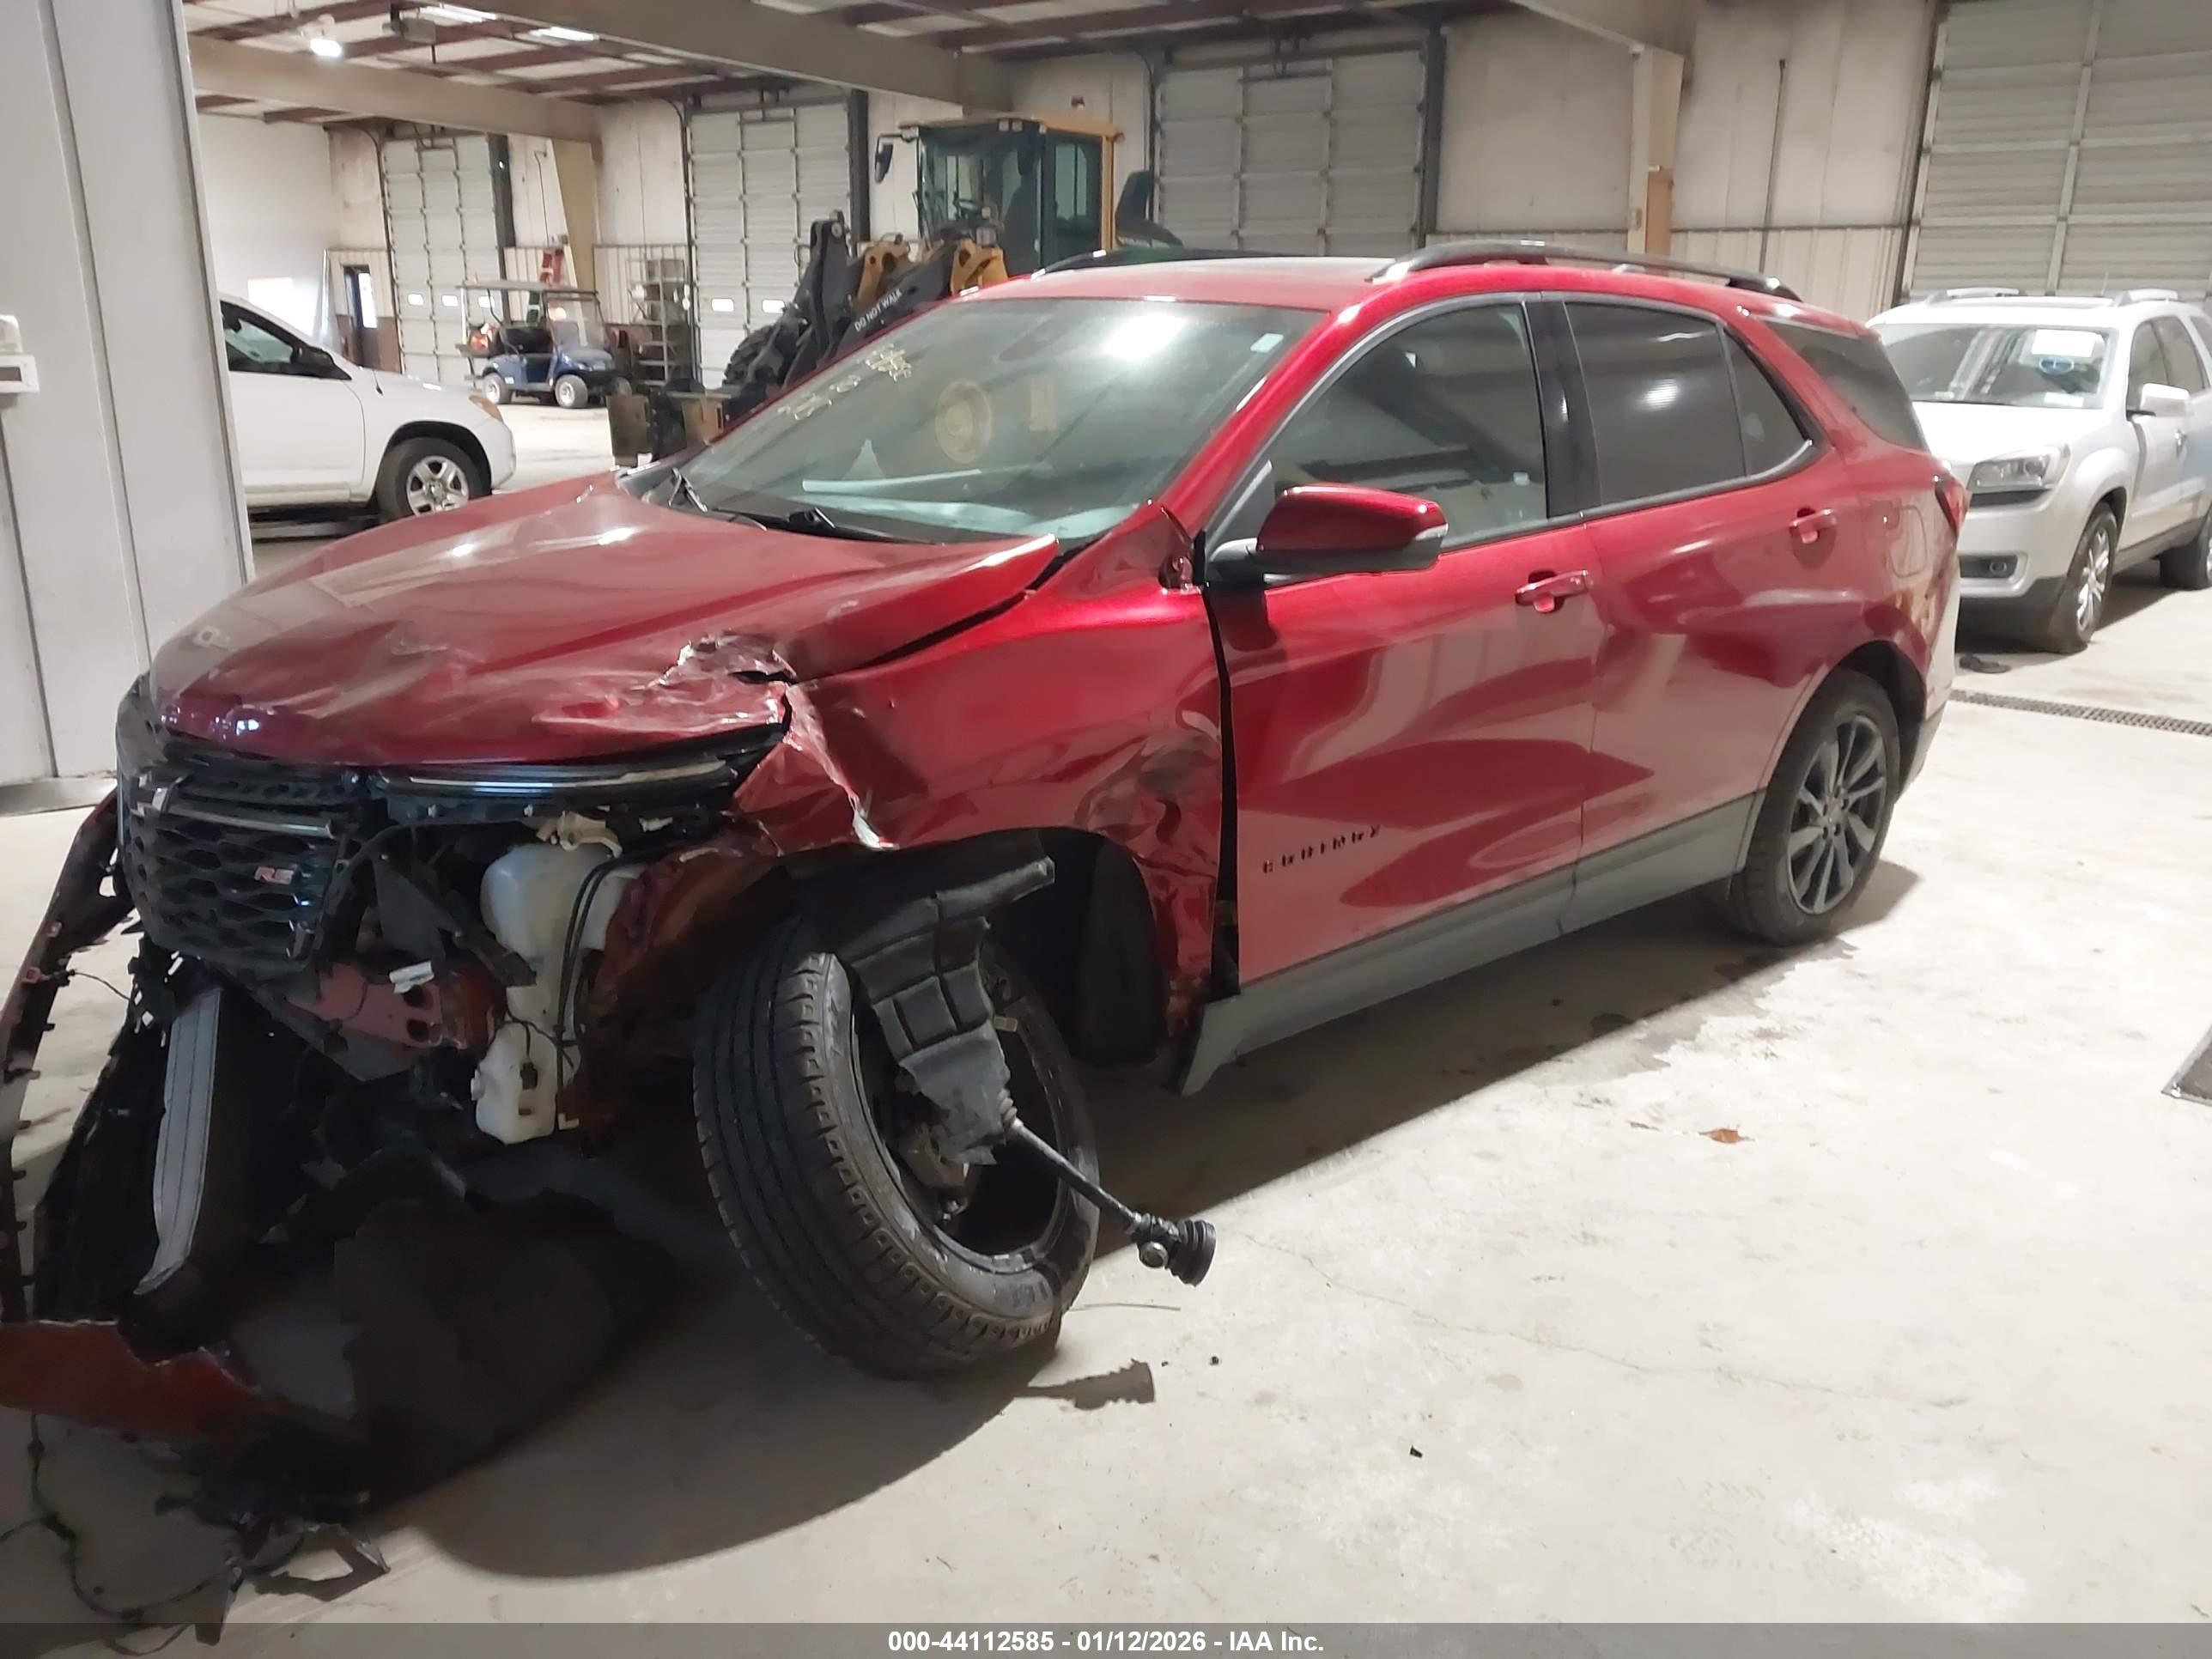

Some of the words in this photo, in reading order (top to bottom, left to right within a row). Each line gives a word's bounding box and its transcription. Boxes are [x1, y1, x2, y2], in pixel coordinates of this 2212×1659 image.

[854, 317, 866, 332] DO
[866, 301, 881, 322] NOT
[881, 288, 902, 309] WALK
[254, 866, 294, 885] RS
